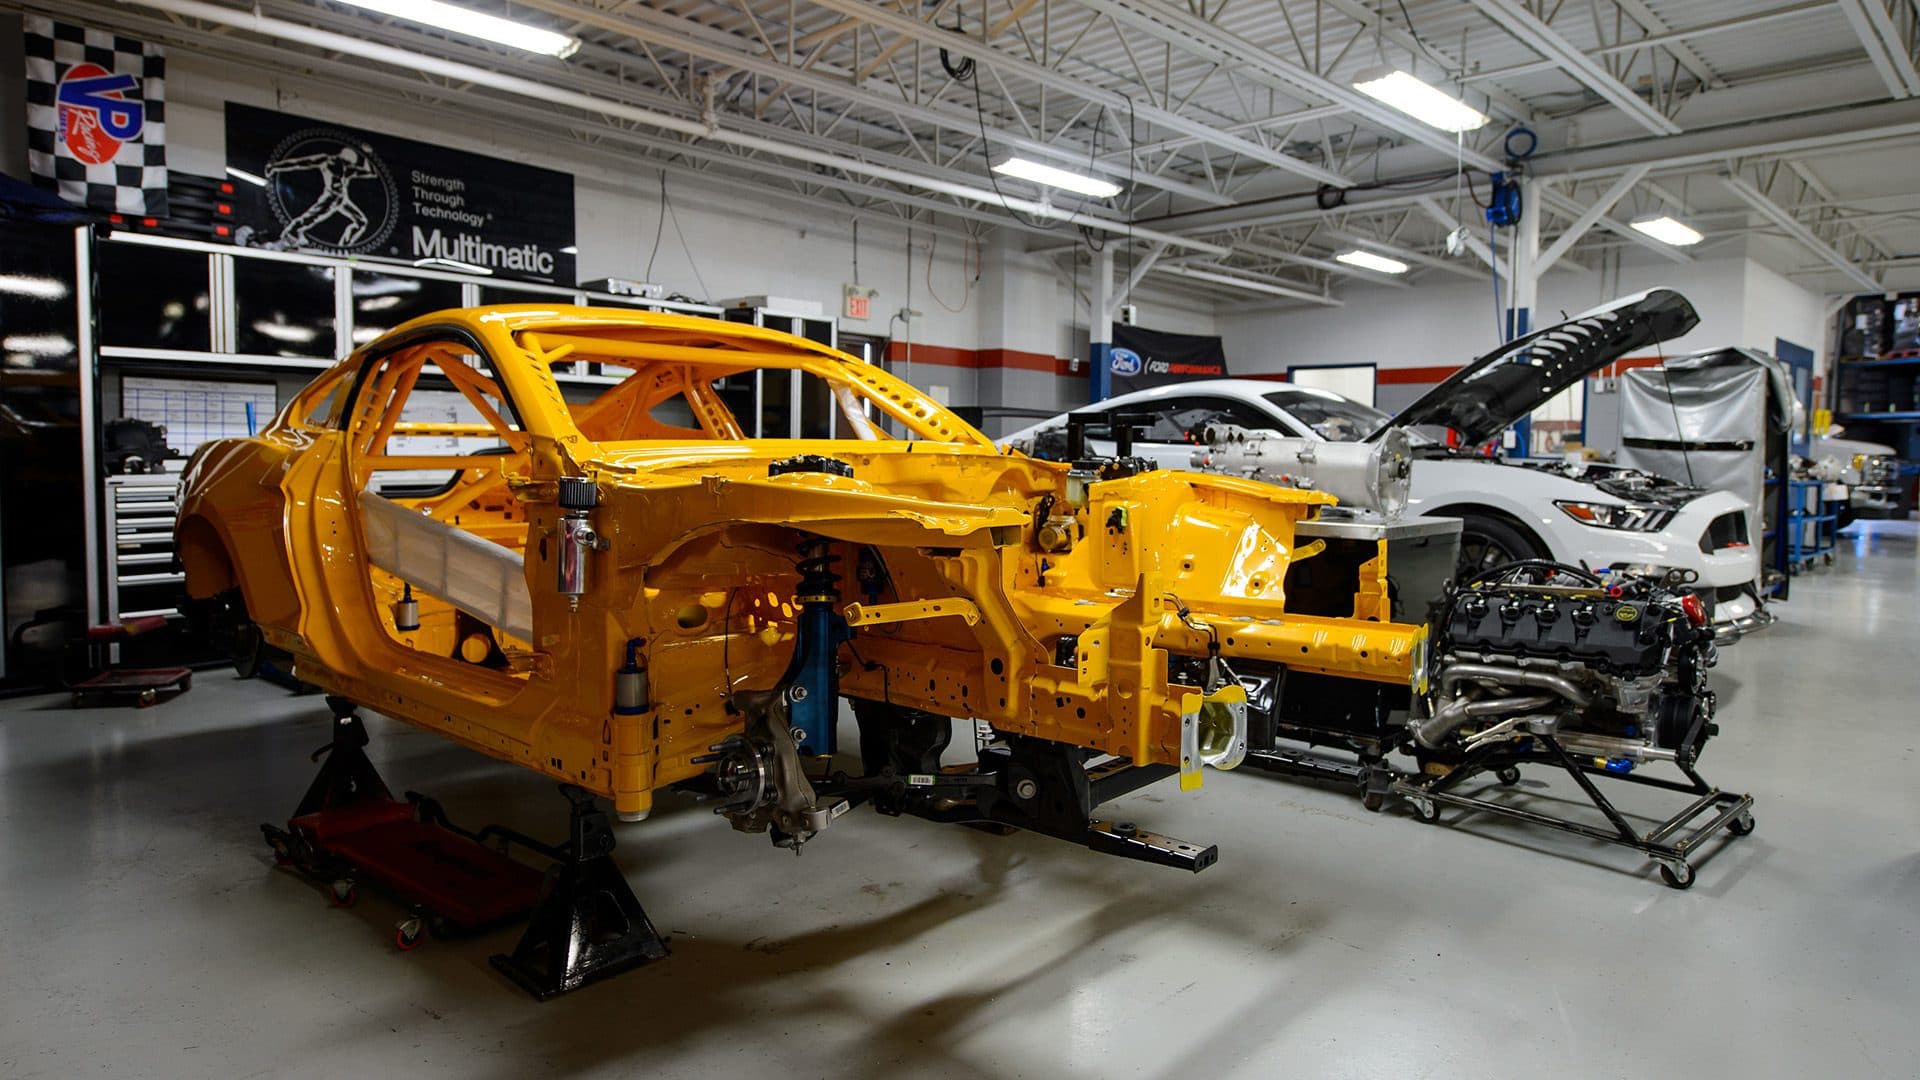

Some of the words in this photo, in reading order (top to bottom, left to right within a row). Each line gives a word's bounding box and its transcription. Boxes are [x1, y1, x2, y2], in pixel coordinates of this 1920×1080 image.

[57, 73, 145, 142] VP
[67, 107, 101, 164] Racing
[411, 170, 465, 191] Strength
[411, 186, 465, 208] Through
[412, 225, 554, 274] Multimatic
[849, 296, 868, 318] EXIT
[1111, 351, 1135, 372] Ford
[1150, 361, 1169, 373] FORD
